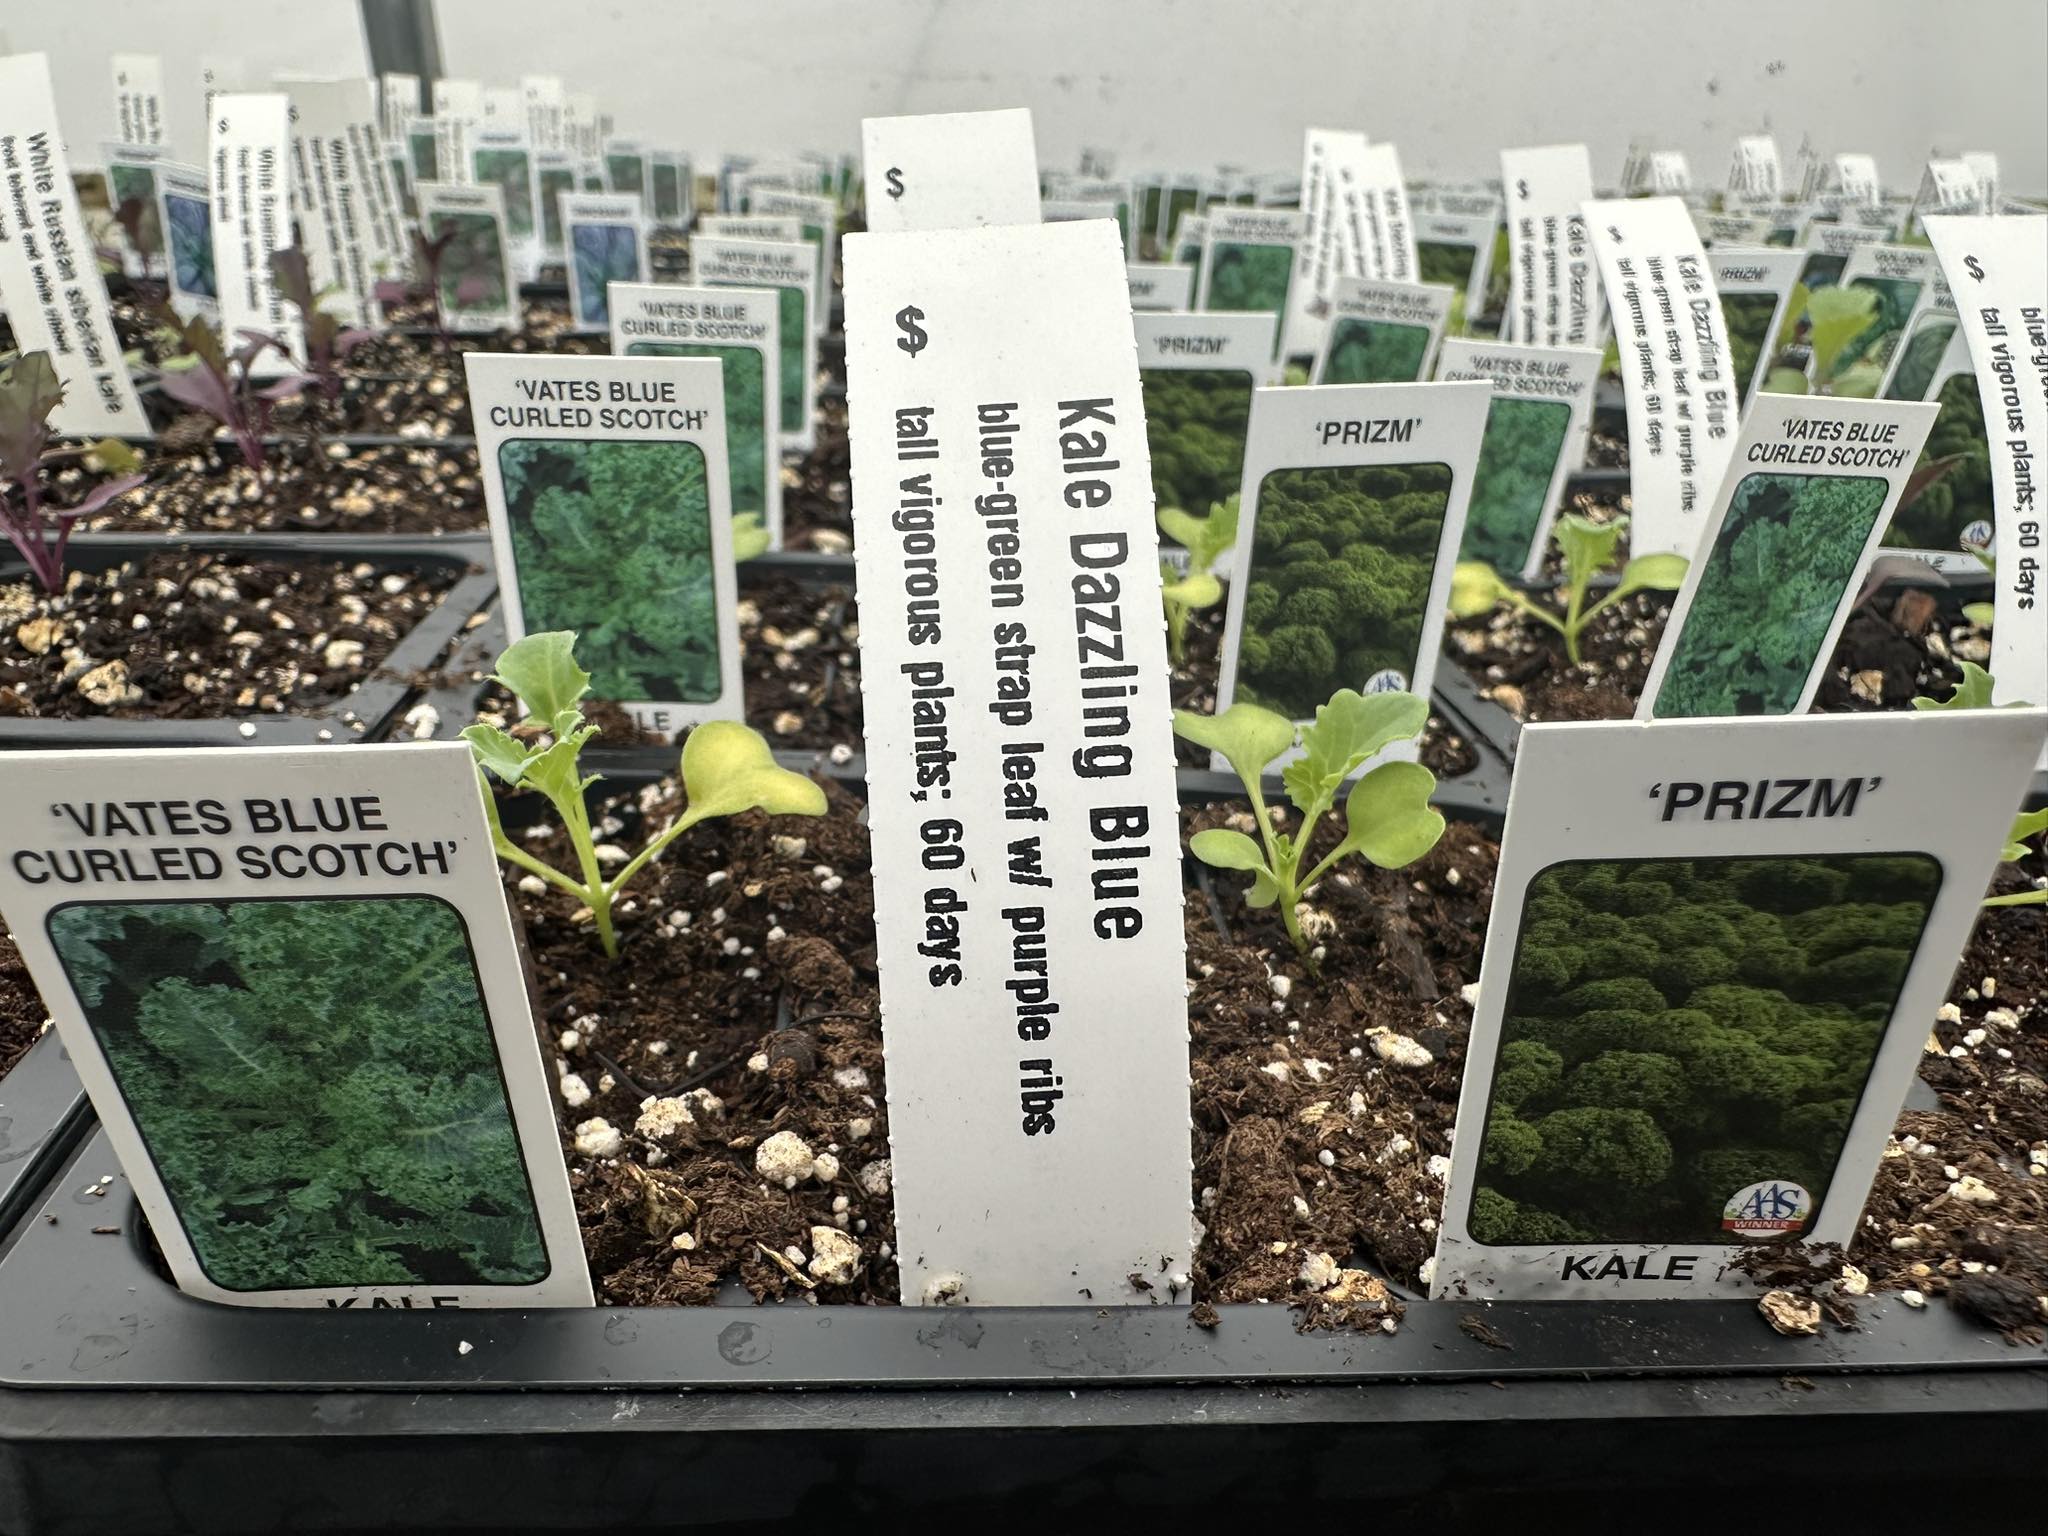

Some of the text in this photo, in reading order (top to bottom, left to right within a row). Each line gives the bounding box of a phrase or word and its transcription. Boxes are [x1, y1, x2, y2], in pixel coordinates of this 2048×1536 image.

[885, 167, 905, 200] $
[26, 130, 54, 195] White
[41, 198, 77, 282] Russian
[1606, 225, 1623, 245] $
[1963, 255, 1985, 283] $
[896, 305, 928, 358] $
[1676, 254, 1728, 440] Kale Dazzling Blue
[609, 381, 676, 404] BLUE
[489, 405, 592, 428] CURLED
[1845, 422, 1899, 443] BLUE
[1747, 442, 1825, 464] CURLED
[1980, 307, 2040, 610] tall vigorous plants; 60 days
[1058, 398, 1151, 939] Kale Dazzling Blue
[892, 407, 968, 988] tall vigorous plants; 60 days
[975, 402, 1063, 1136] blue-green strap leaf w/ purple ribs
[246, 796, 389, 833] BLUE
[13, 846, 223, 884] CURLED
[1737, 1183, 1800, 1219] AAS
[1734, 1220, 1790, 1230] WINNER
[1560, 1253, 1698, 1282] KALE
